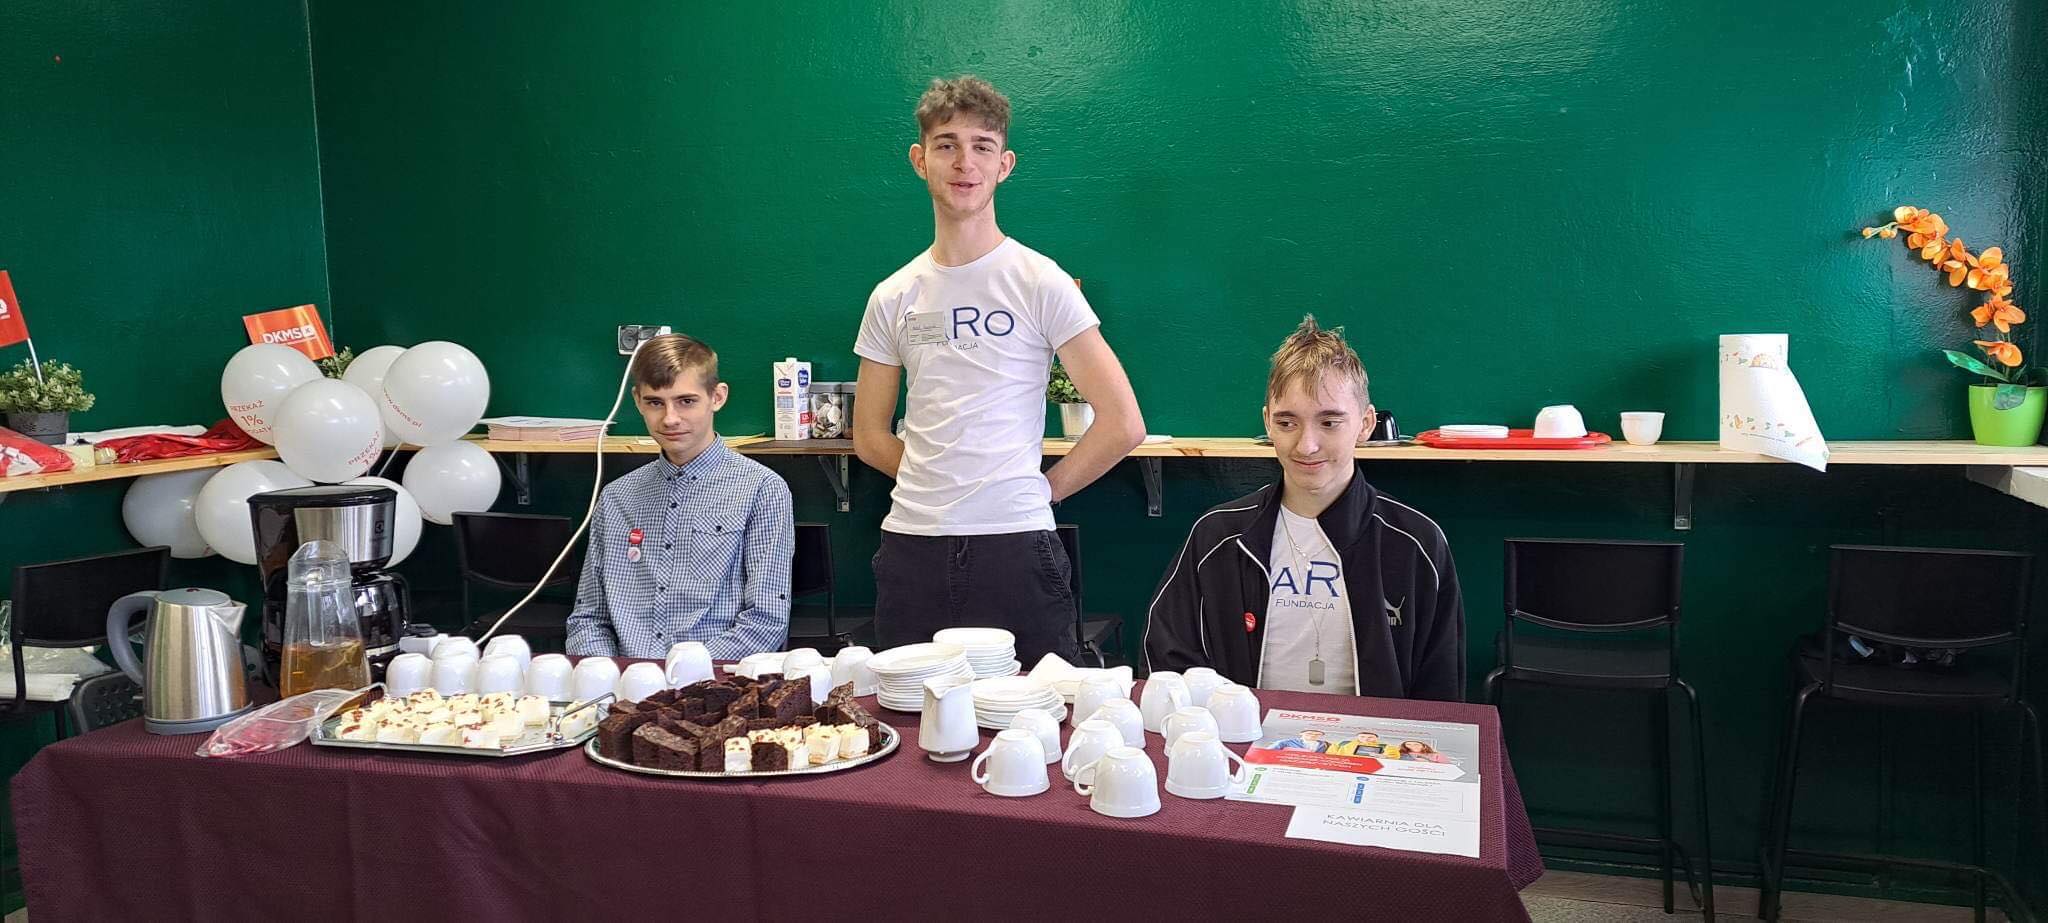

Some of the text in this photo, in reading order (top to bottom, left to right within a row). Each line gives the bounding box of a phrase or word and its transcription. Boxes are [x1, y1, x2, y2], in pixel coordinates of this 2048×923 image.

[263, 327, 302, 344] DKMS
[241, 414, 264, 426] 1%
[1275, 598, 1335, 611] FUNDACJA
[1279, 713, 1326, 721] DKMS
[1322, 820, 1391, 831] NASZYCH
[1327, 814, 1443, 830] KAWIARNIA DLA
